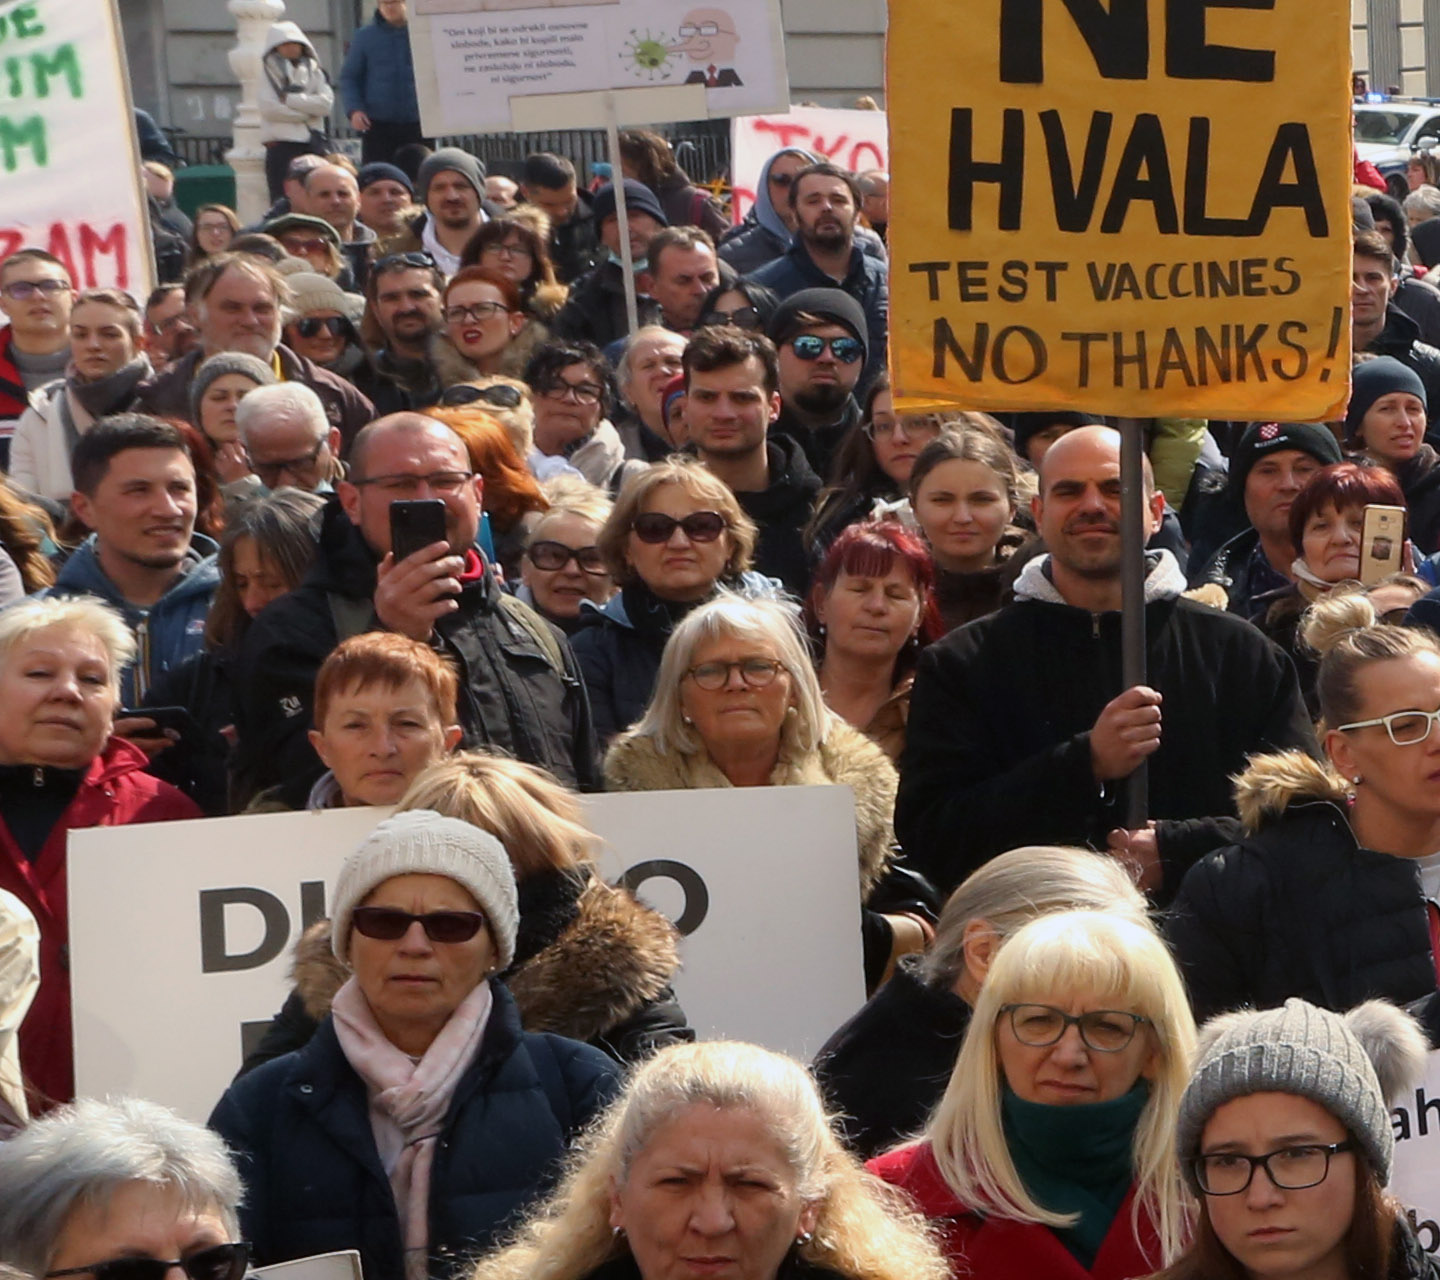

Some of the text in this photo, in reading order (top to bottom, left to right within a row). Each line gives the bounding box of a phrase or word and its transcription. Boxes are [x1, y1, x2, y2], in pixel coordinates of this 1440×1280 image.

[948, 107, 1329, 238] HVALA
[908, 256, 1302, 303] TEST VACCINES
[932, 306, 1343, 390] NO THANKS!
